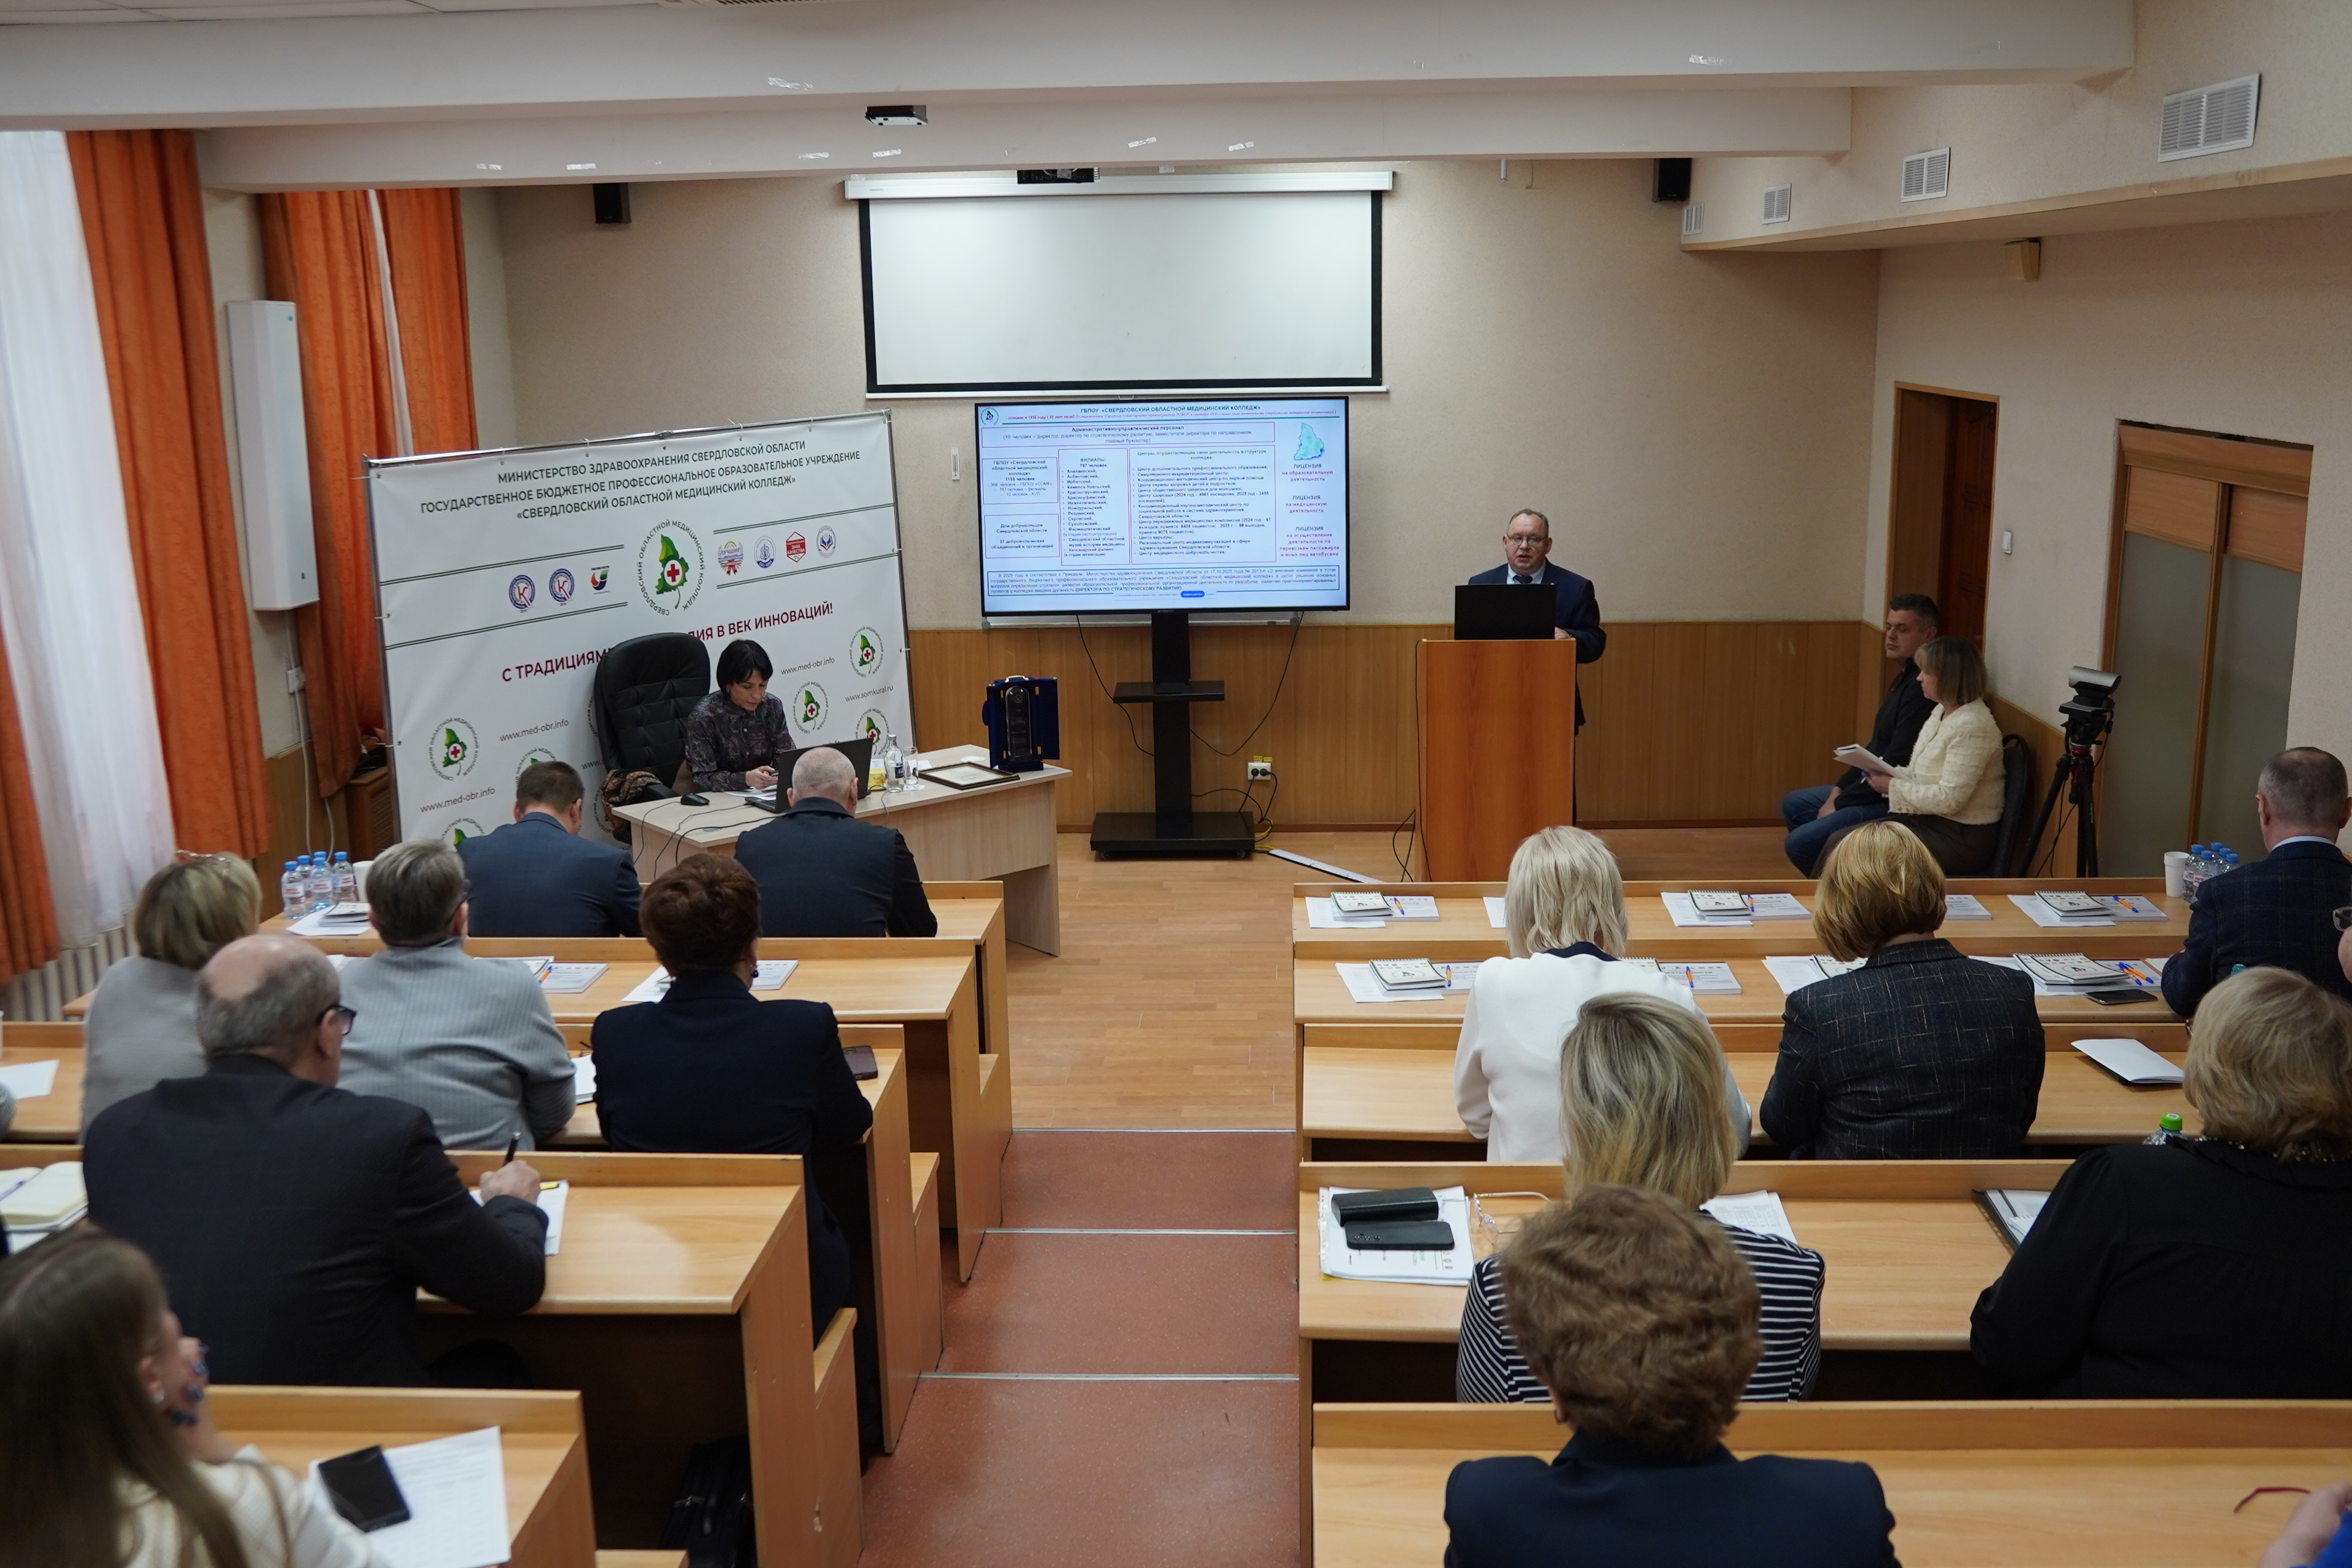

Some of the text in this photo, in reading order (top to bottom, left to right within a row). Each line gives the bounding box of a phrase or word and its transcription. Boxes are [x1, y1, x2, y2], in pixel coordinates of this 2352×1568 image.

[421, 451, 860, 513] ГОСУДАРСТВЕННОЕ БЮДЖЕТНОЕ ПРОФЕССИОНАЛЬНОЕ ОБРАЗОВАТЕЛЬНОЕ УЧРЕЖДЕНИЕ
[498, 440, 806, 483] МИНИСТЕРСТВО ЗДРАВООХРАНЕНИЯ СВЕРДЛОВСКОЙ ОБЛАСТИ
[517, 476, 796, 519] «СВЕРДЛОВСКИЙ ОБЛАСТНОЙ МЕДИЦИНСКИЙ КОЛЛЕДЖ»
[639, 519, 670, 559] ОБЛАСТНОЙ
[672, 520, 706, 569] МЕДИЦИНСКИЙ
[636, 562, 670, 615] СВЕРДЛОВСКИЙ
[682, 573, 704, 611] КОЛЛЕДЖ
[502, 669, 512, 682] С
[515, 649, 612, 679] ТРАДИЦИЯМ
[717, 625, 725, 638] В
[728, 619, 752, 635] ВЕК
[755, 602, 834, 629] ИННОВАЦИЙ!
[780, 656, 835, 675] www.med-obr.info
[846, 685, 893, 702] www.somkural.ru
[500, 719, 569, 742] www.med-obr.info
[419, 786, 495, 813] www.med-obr.info
